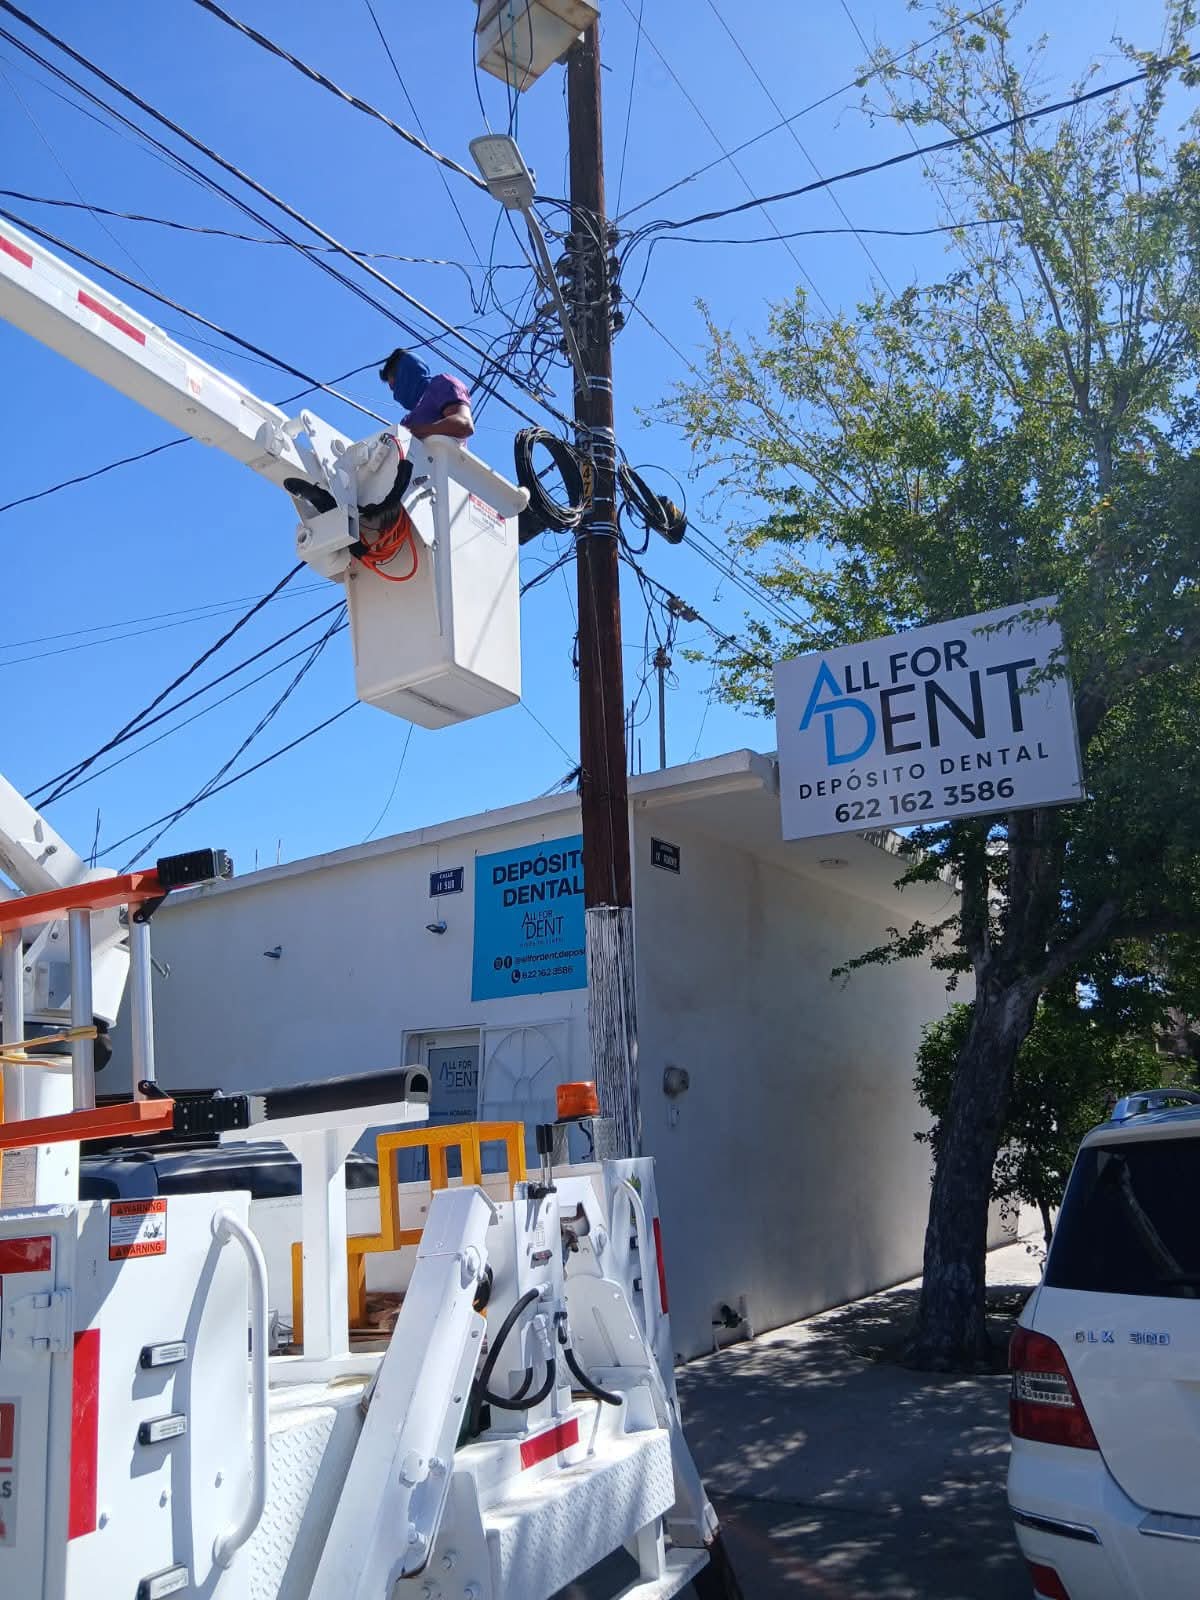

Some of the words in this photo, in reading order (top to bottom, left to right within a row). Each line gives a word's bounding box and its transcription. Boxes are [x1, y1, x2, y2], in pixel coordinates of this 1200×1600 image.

[799, 659, 880, 731] ALL
[889, 639, 969, 684] FOR
[813, 657, 1037, 767] DENT
[799, 766, 926, 800] DEPÓSITO
[940, 742, 1049, 775] DENTAL
[835, 798, 882, 823] 622
[889, 790, 935, 815] 162
[943, 777, 1015, 807] 3586
[492, 849, 584, 885] DEPÓSIT
[503, 875, 585, 907] DENTAL
[524, 915, 565, 939] DENT
[448, 1071, 479, 1087] DENT
[125, 1201, 162, 1214] WARNING
[122, 1242, 161, 1256] WARNING
